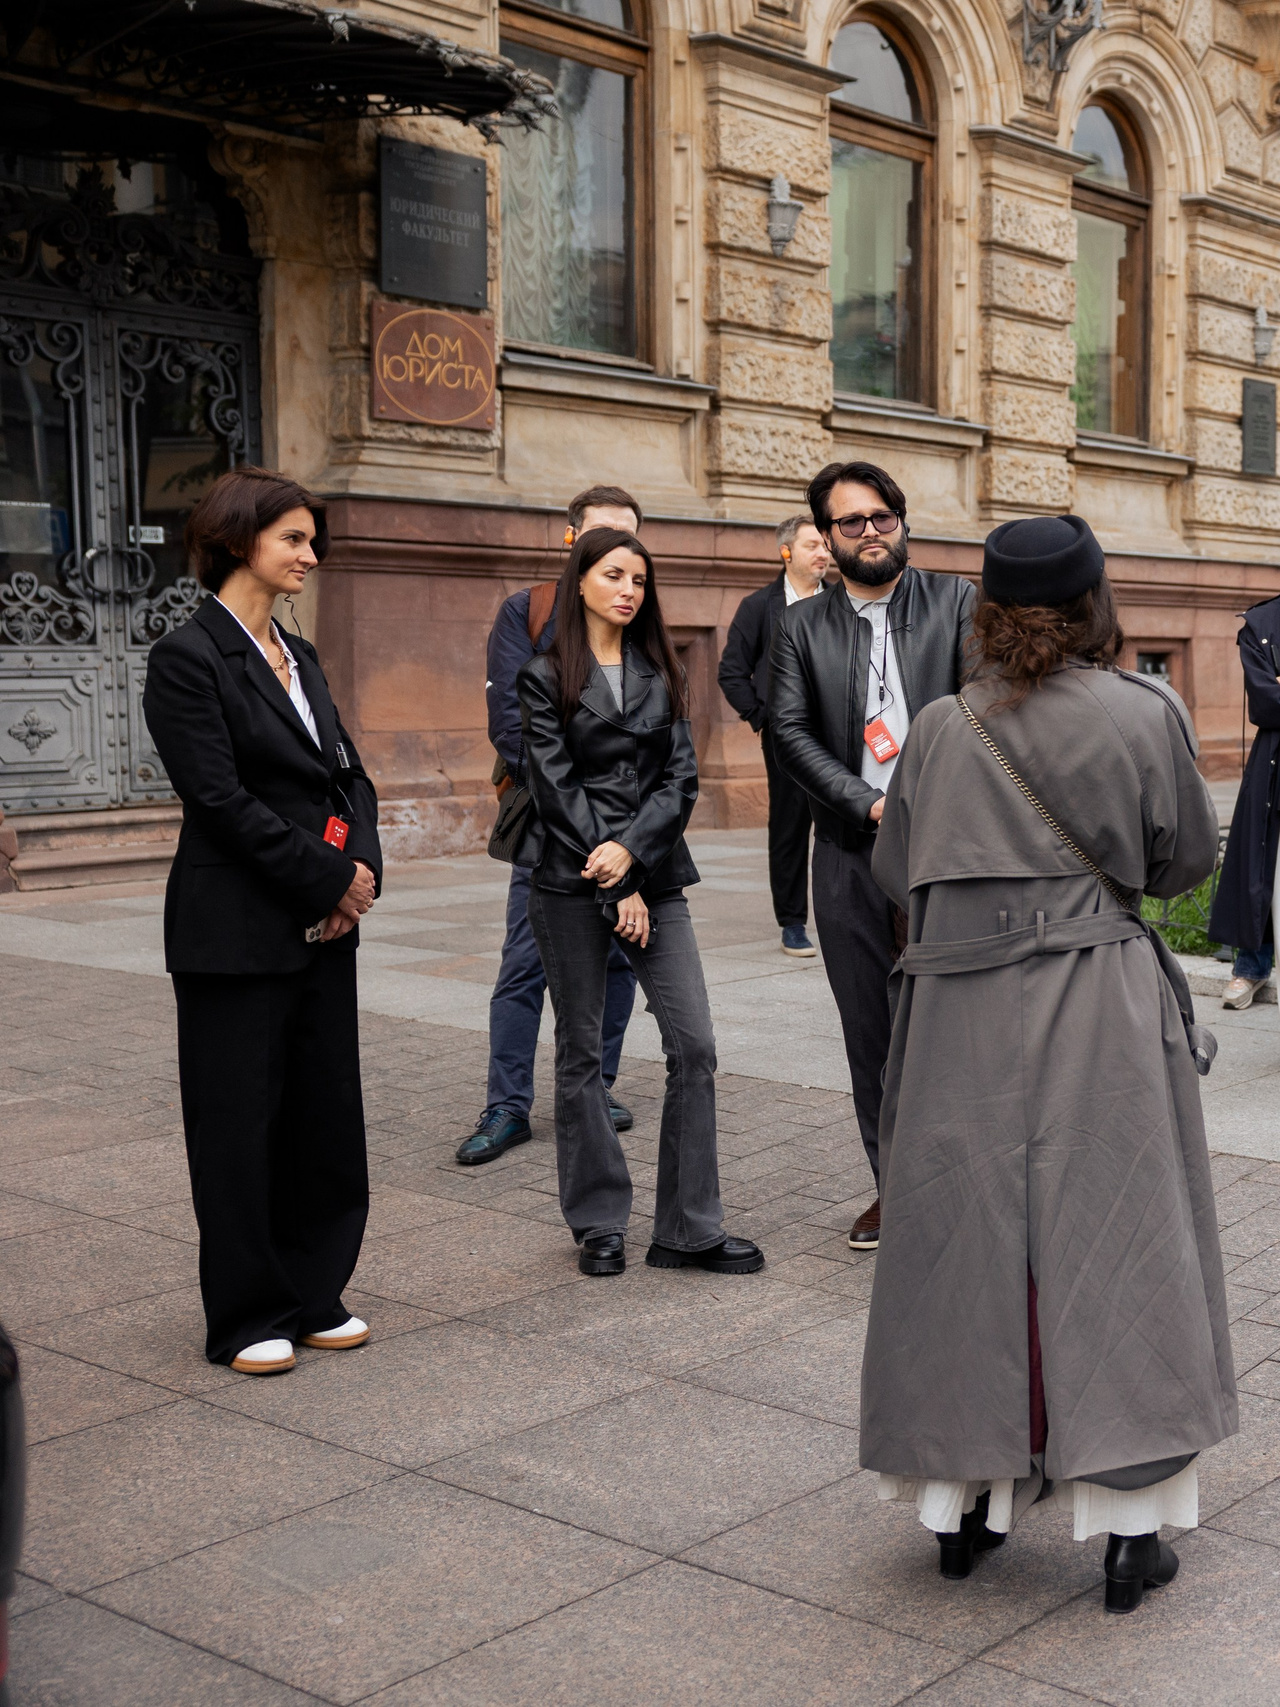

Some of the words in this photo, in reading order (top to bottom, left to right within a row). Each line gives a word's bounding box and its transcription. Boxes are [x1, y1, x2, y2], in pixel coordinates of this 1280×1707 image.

[390, 196, 480, 229] ЮРИДИЧЕСКИЙ
[401, 220, 470, 247] ФАКУЛЬТЕТ
[405, 331, 464, 362] ДОМ
[383, 354, 489, 392] ЮРИСТА
